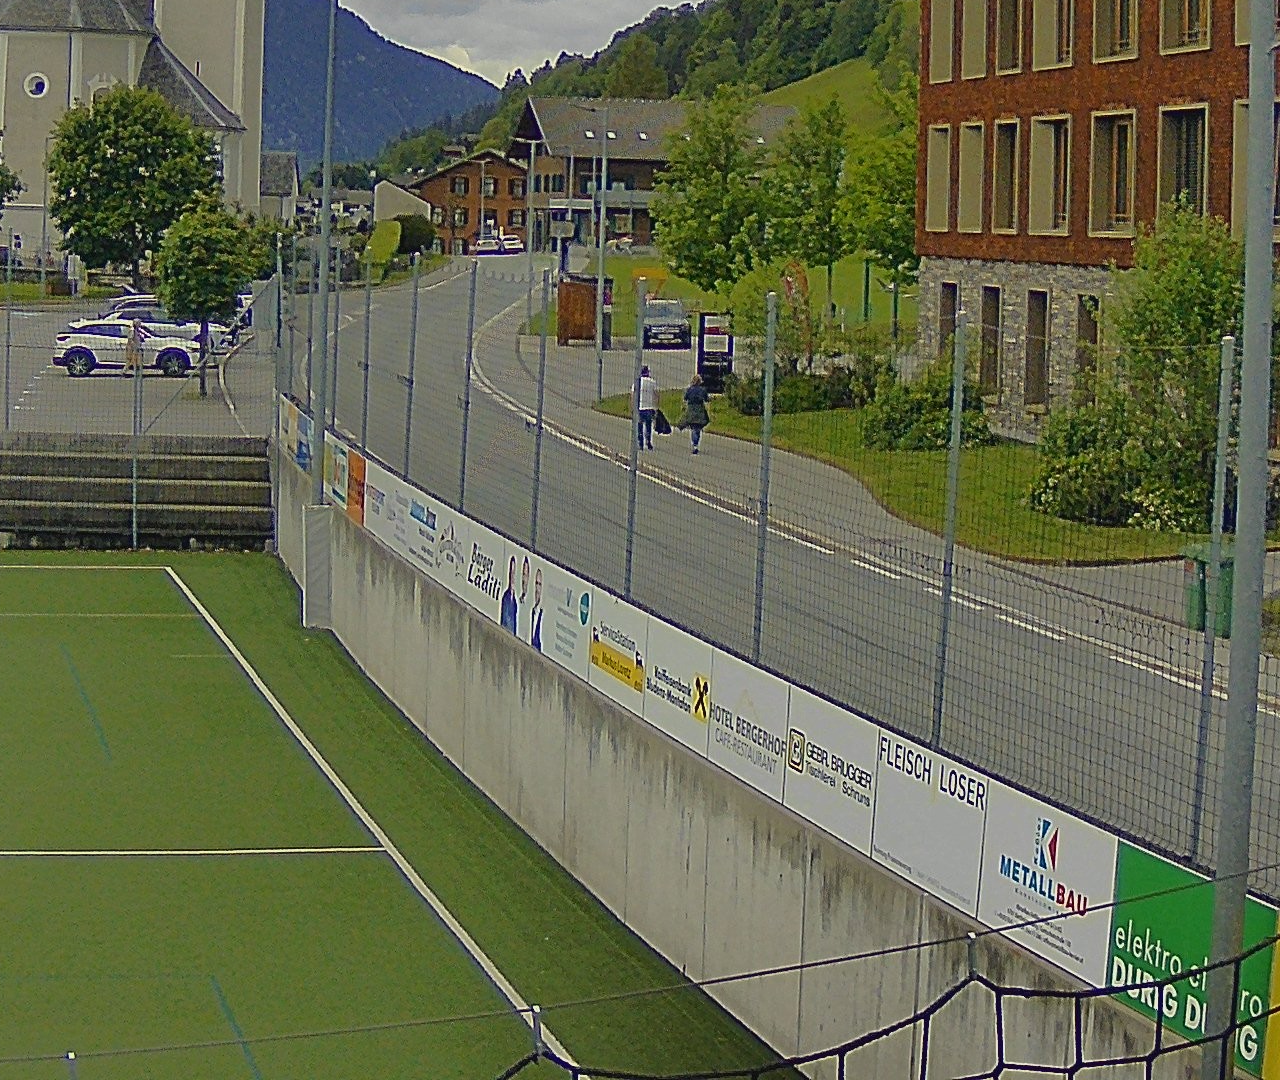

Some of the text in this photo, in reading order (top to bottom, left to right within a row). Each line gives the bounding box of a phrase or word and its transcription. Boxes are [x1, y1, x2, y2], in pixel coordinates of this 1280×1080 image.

[710, 701, 734, 731] HOTEL
[831, 754, 873, 791] BRUGGER
[842, 781, 871, 808] Schruns
[879, 735, 986, 811] FLEISCH LOSER
[999, 853, 1089, 917] METALLBAU
[1115, 919, 1182, 976] elektro
[1111, 955, 1178, 1018] DURIG
